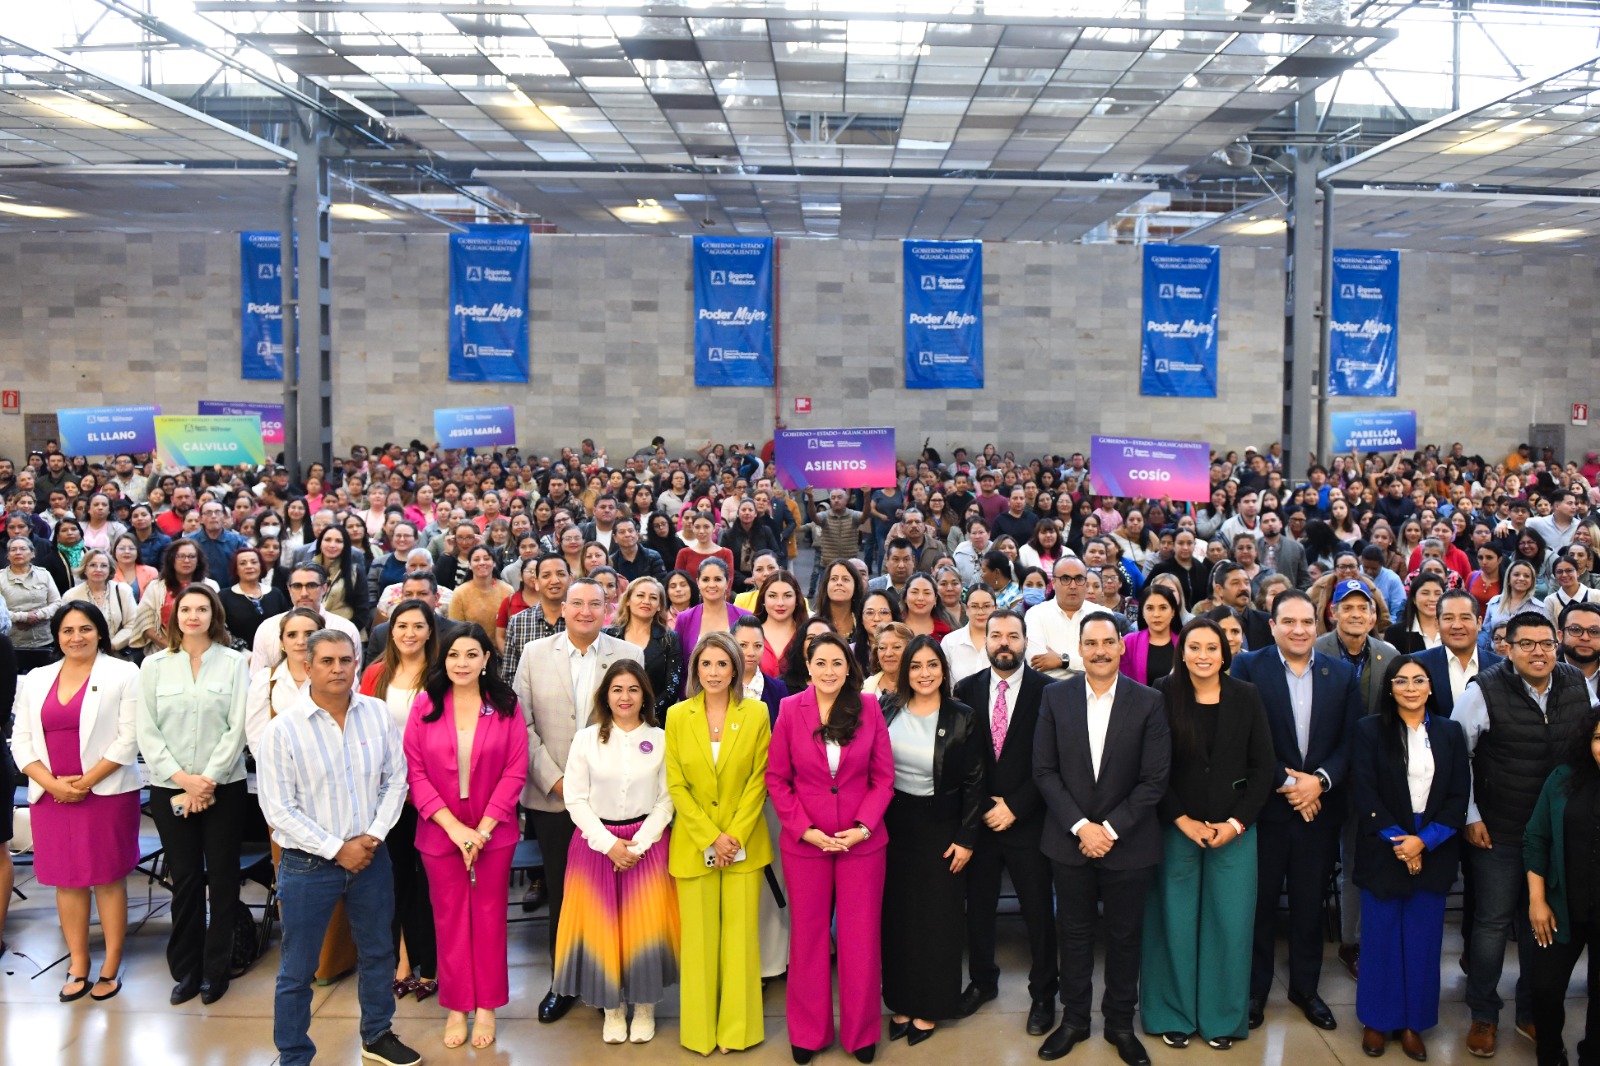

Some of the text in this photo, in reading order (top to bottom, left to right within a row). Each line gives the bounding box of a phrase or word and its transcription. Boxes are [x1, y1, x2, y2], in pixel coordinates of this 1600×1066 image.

[740, 242, 765, 250] ESTADO
[247, 302, 280, 314] Poder
[454, 303, 523, 322] Poder Mujer
[698, 306, 768, 325] Poder Mujer
[909, 310, 978, 329] Poder Mujer
[1147, 319, 1214, 338] Poder Mujer
[1330, 320, 1361, 332] Poder
[87, 430, 137, 442] EL LLANO
[448, 425, 502, 438] JESÚS MARÍA
[1350, 428, 1398, 439] PABELLÓN
[182, 442, 238, 451] CALVILLO
[1099, 437, 1128, 445] GOBIERNO
[1345, 437, 1403, 447] DE ARTEAGA
[804, 459, 867, 471] ASIENTOS
[1128, 468, 1171, 482] COSÍO
